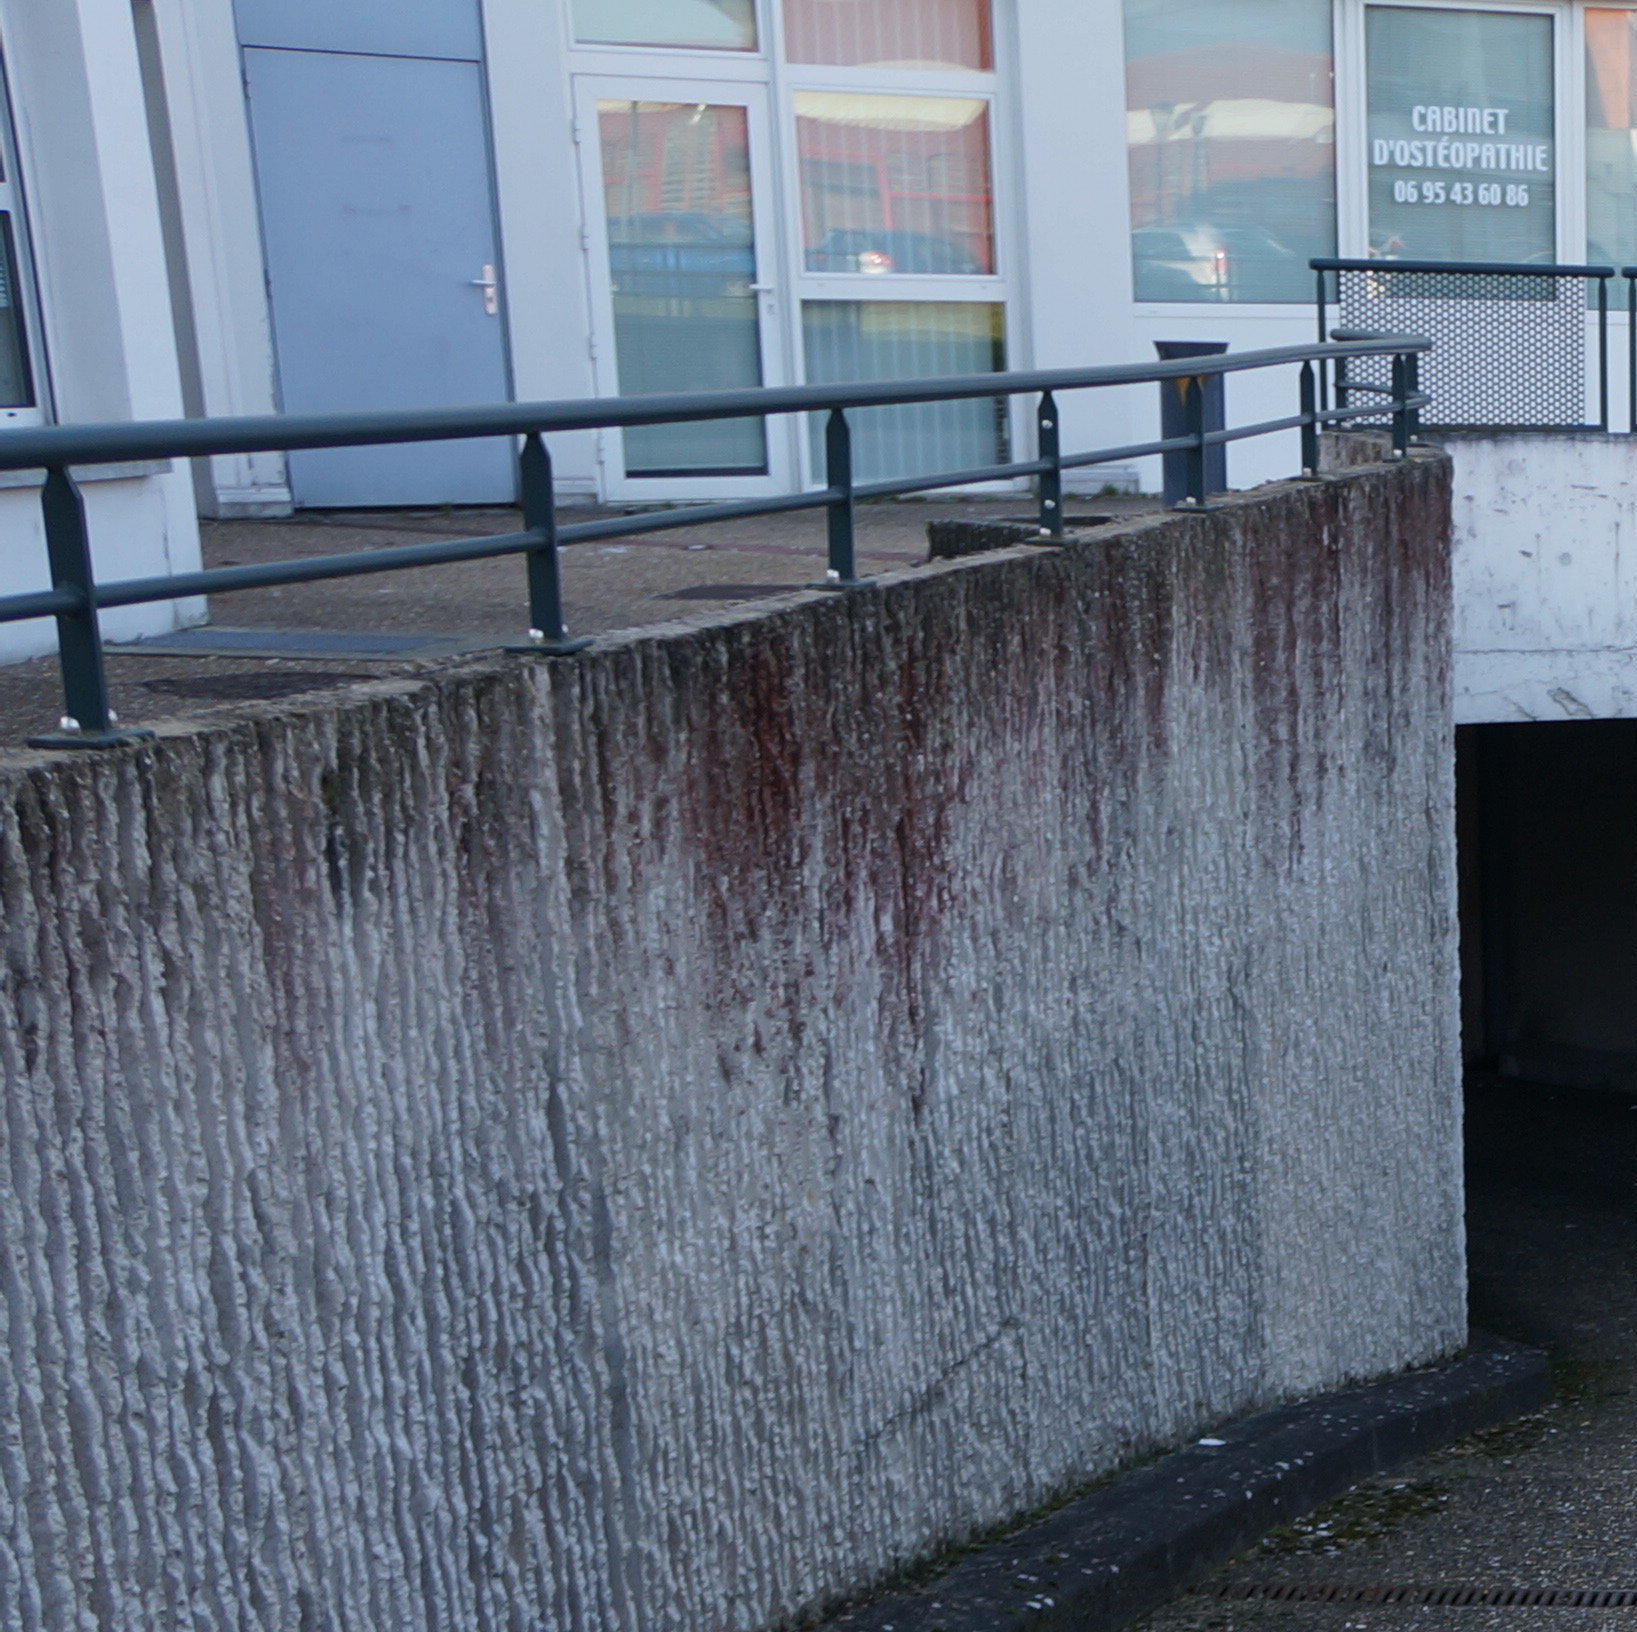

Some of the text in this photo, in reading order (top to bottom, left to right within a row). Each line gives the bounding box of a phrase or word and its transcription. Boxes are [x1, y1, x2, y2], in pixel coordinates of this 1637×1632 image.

[1412, 105, 1509, 135] CABINET
[1373, 136, 1549, 171] D'OSTÉOPATHIE
[1394, 180, 1529, 206] 06 95 43 60 86
